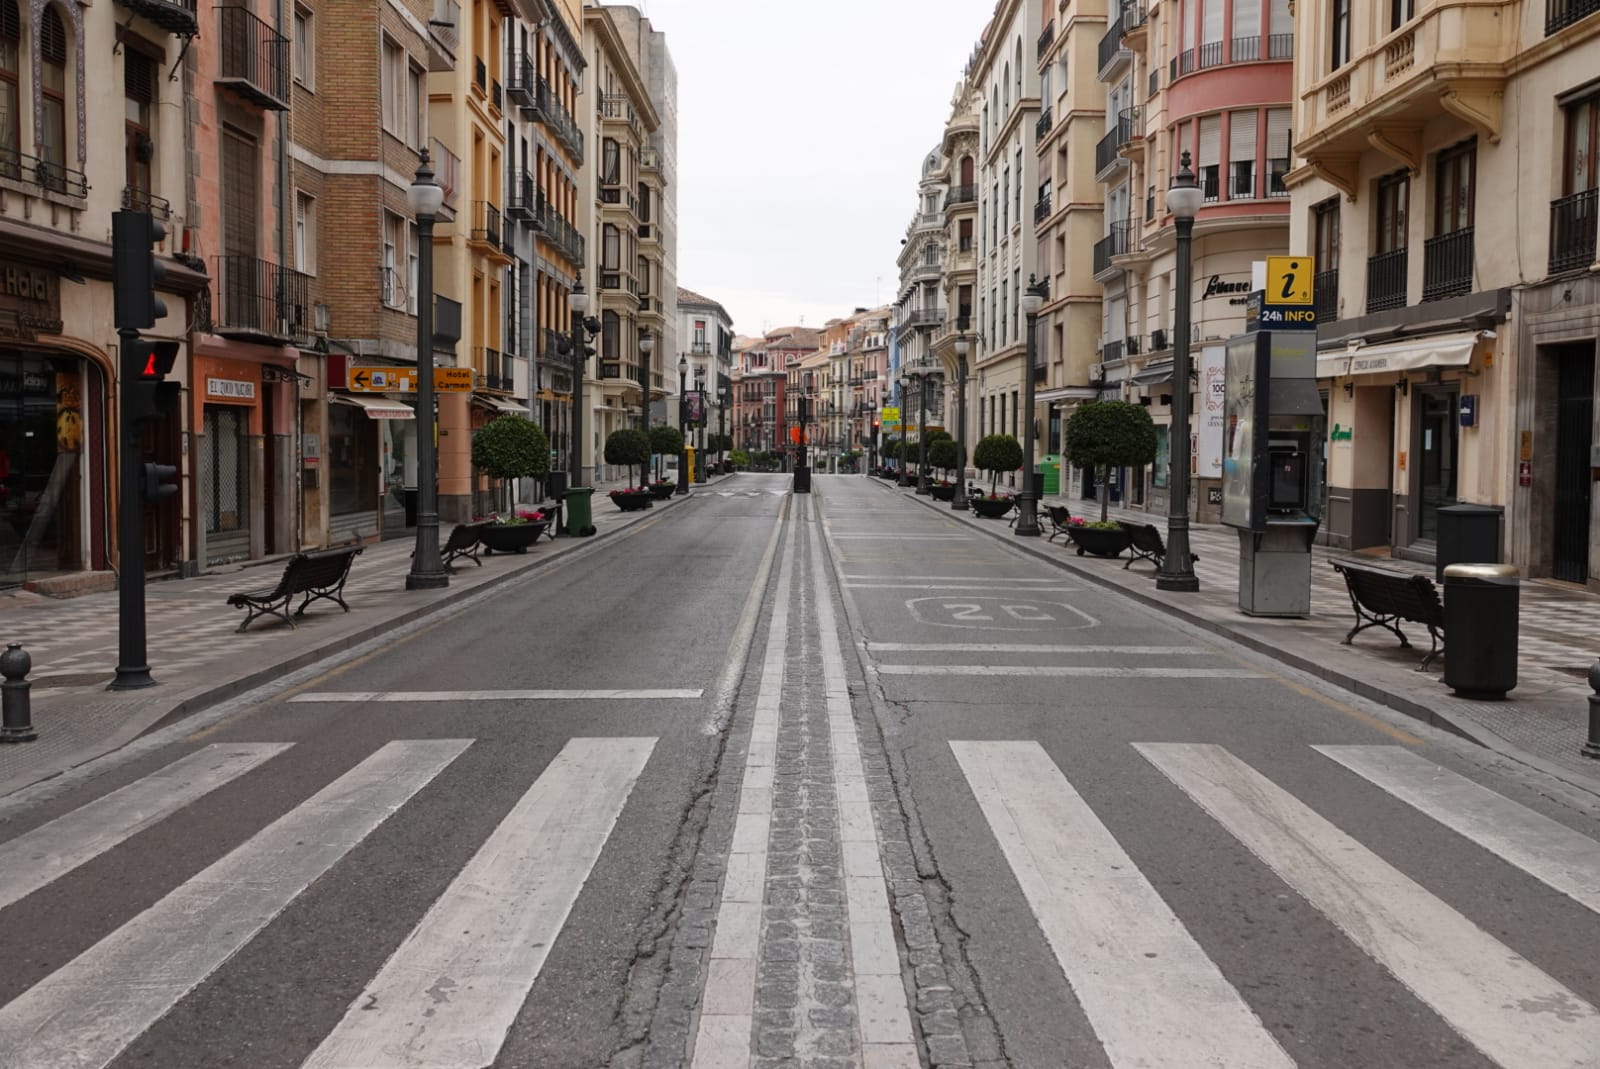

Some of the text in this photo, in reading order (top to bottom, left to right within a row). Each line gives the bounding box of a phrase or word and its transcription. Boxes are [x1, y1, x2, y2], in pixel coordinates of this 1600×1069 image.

[1262, 310, 1315, 322] 24h INFO
[438, 381, 470, 389] Carmen
